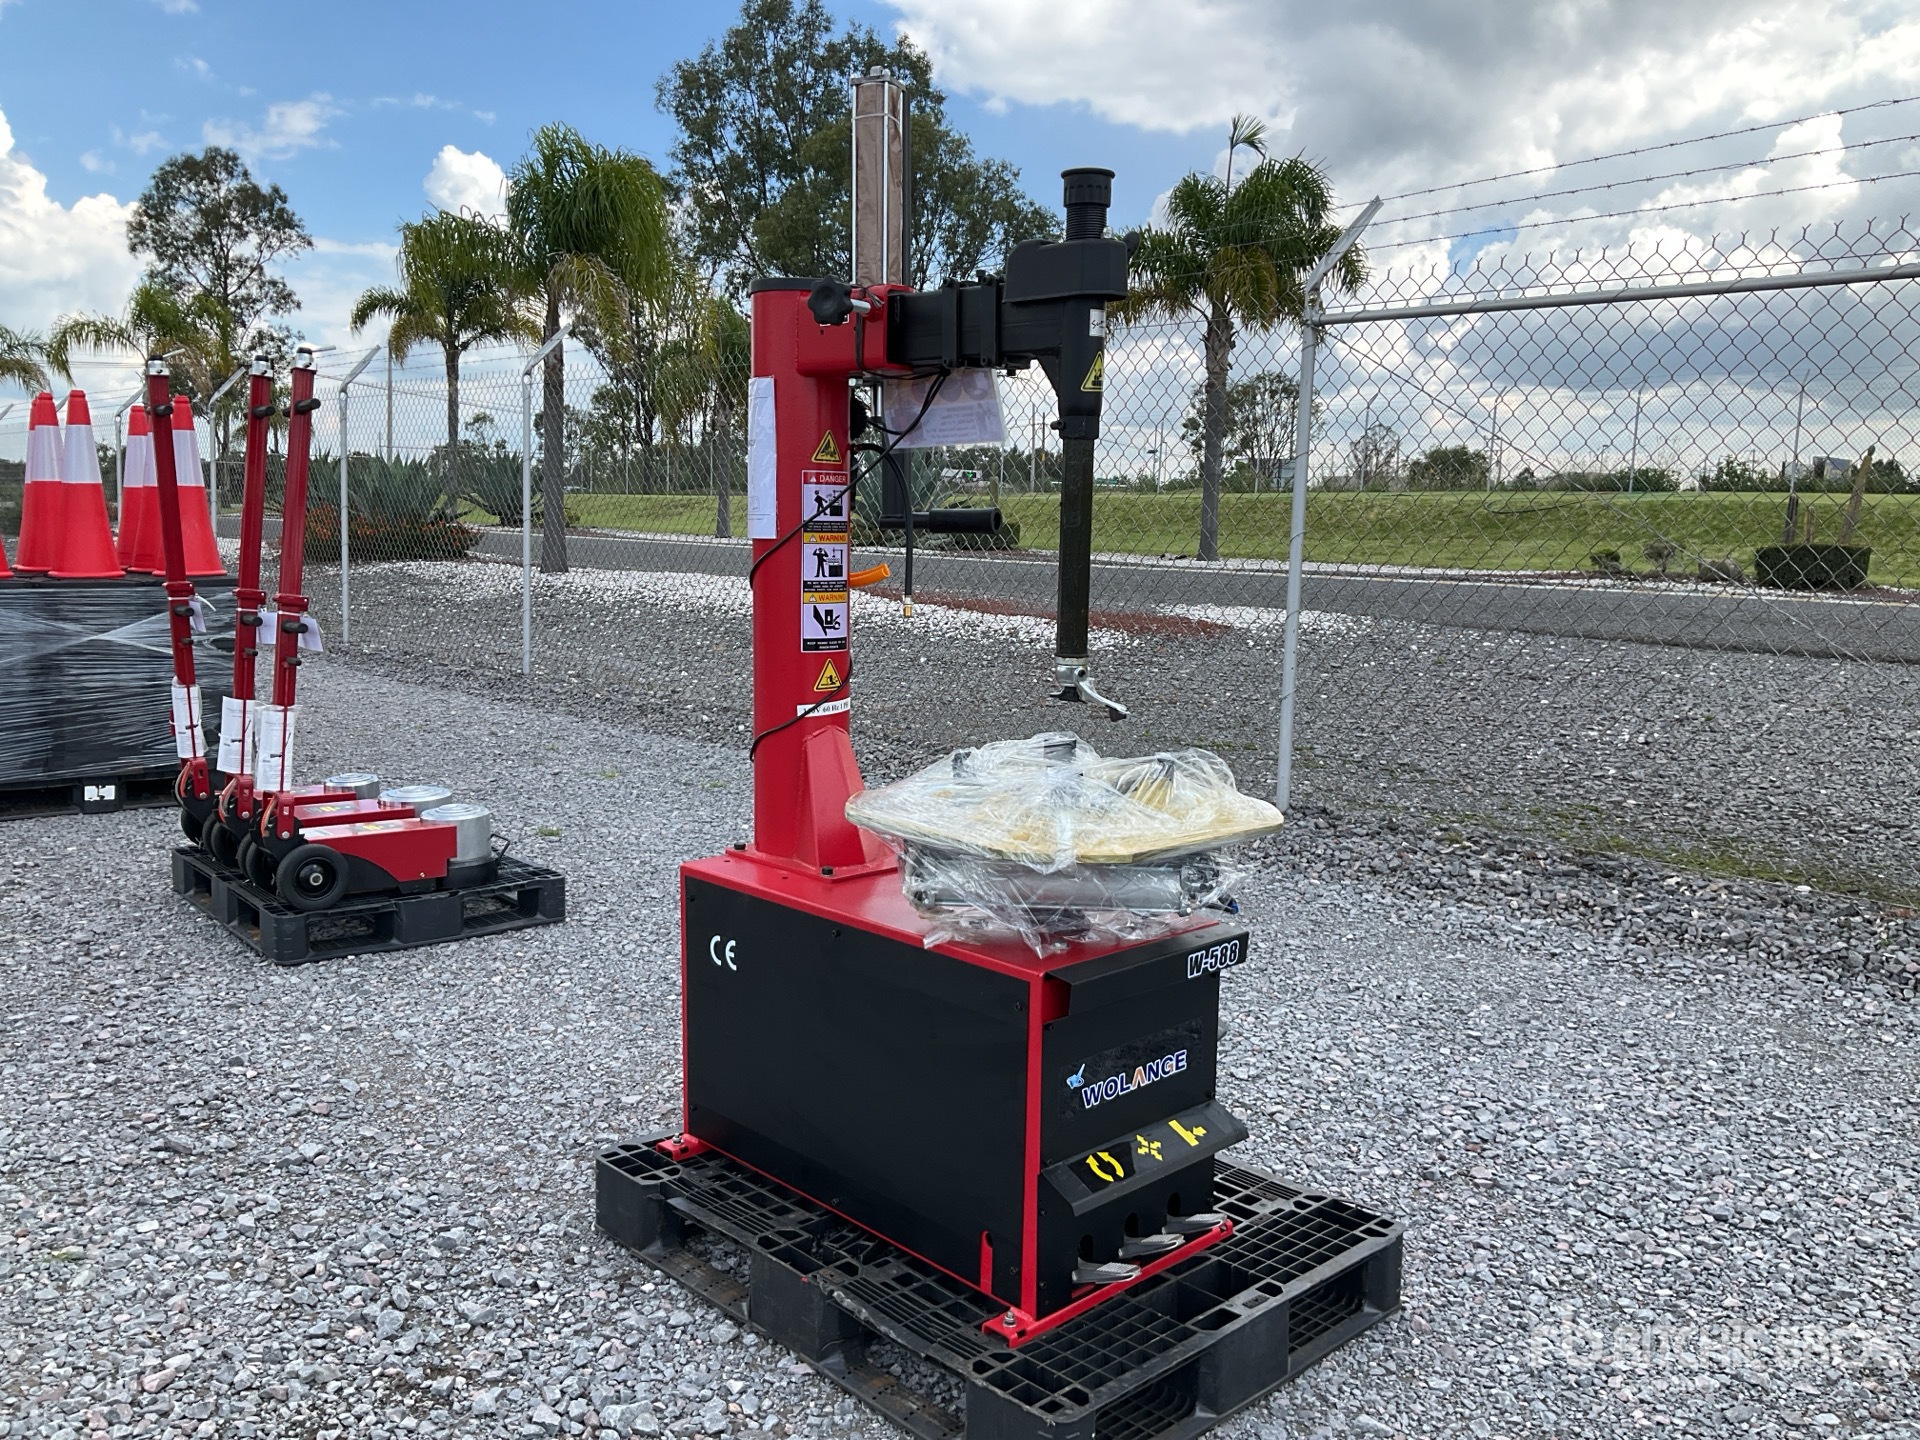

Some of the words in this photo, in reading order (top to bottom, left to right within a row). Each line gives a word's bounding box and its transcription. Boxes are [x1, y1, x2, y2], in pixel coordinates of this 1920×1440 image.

[819, 475, 846, 483] DANGER
[818, 534, 846, 542] WARNING
[709, 935, 737, 971] CE
[1187, 939, 1240, 979] W-588
[1081, 1049, 1188, 1109] WOLANGE
